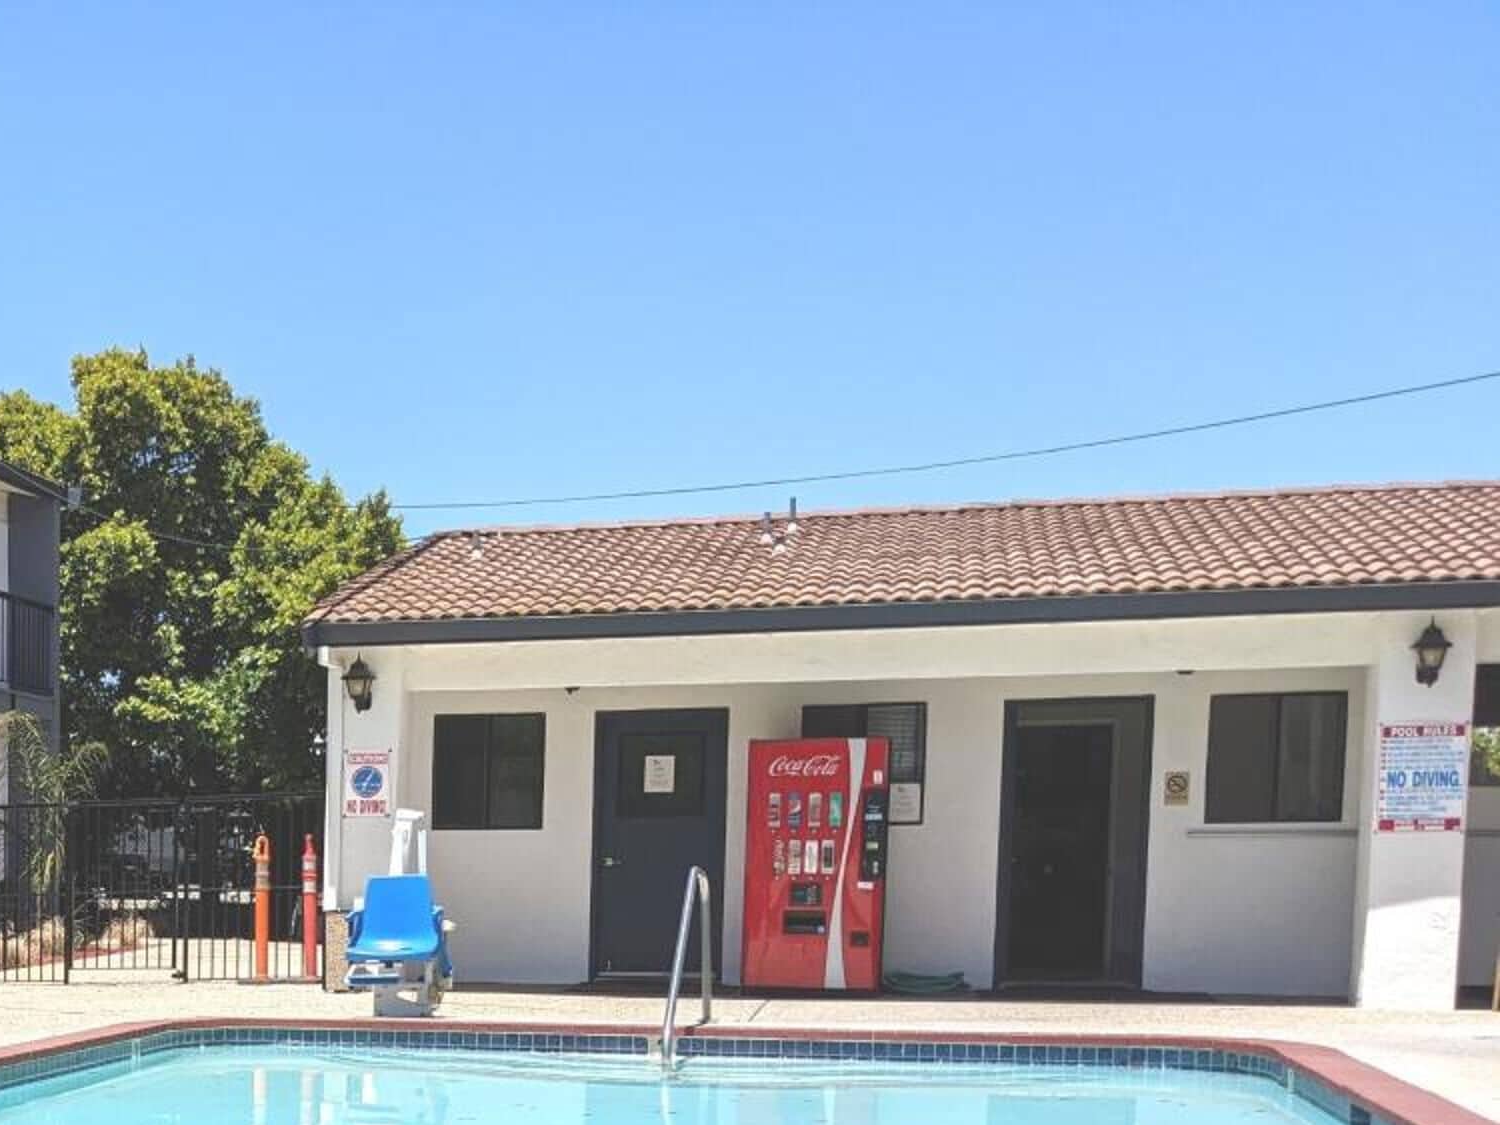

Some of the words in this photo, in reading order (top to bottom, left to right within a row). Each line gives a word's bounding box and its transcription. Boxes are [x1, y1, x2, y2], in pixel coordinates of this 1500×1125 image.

[1391, 727, 1418, 737] POOL
[1387, 770, 1406, 788] NO
[1412, 769, 1460, 787] DIVING
[346, 799, 359, 813] NO
